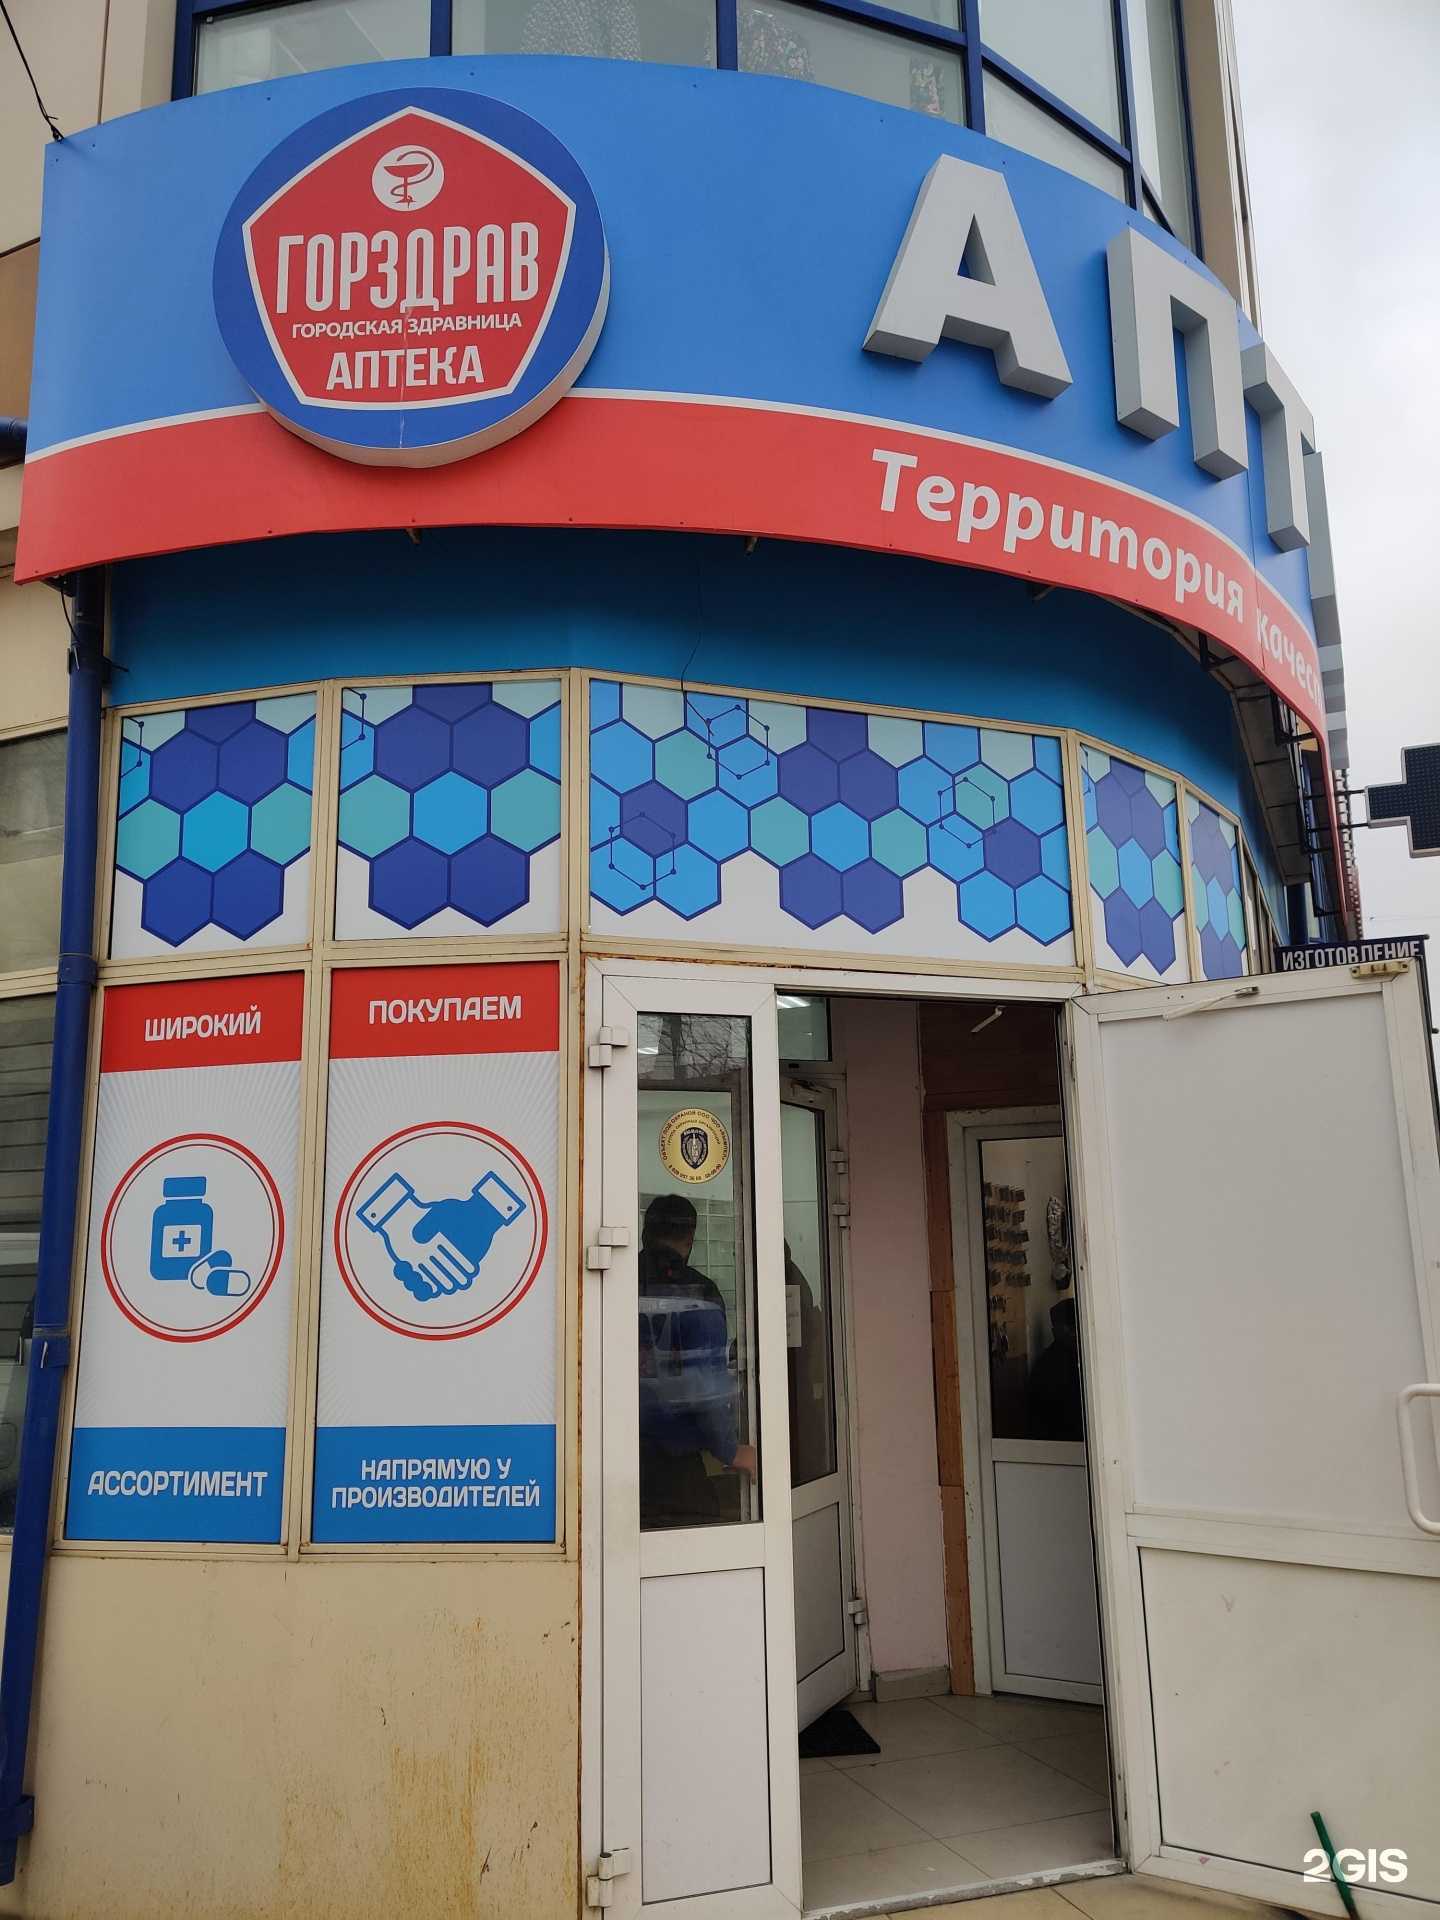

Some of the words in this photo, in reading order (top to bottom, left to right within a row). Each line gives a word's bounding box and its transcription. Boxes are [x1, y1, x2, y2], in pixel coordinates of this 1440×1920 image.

[275, 221, 539, 314] ГОРЗДРАВ
[291, 319, 402, 340] ГОРОДСКАЯ
[407, 312, 522, 336] ЗДРАВНИЦА
[325, 344, 485, 391] АПТЕКА
[863, 153, 1341, 647] АПТ
[871, 448, 1244, 624] Территория
[1282, 940, 1420, 971] ИЗГОТОВЛЕНИЕ
[144, 1003, 262, 1042] ШИРОКИЙ
[368, 995, 522, 1025] ПОКУПАЕМ
[87, 1470, 268, 1497] АССОРТИМЕНТ
[361, 1458, 491, 1481] НАПРЯМУЮ
[497, 1458, 512, 1480] У
[331, 1478, 541, 1509] ПРОИЗВОДИТЕЛЕЙ
